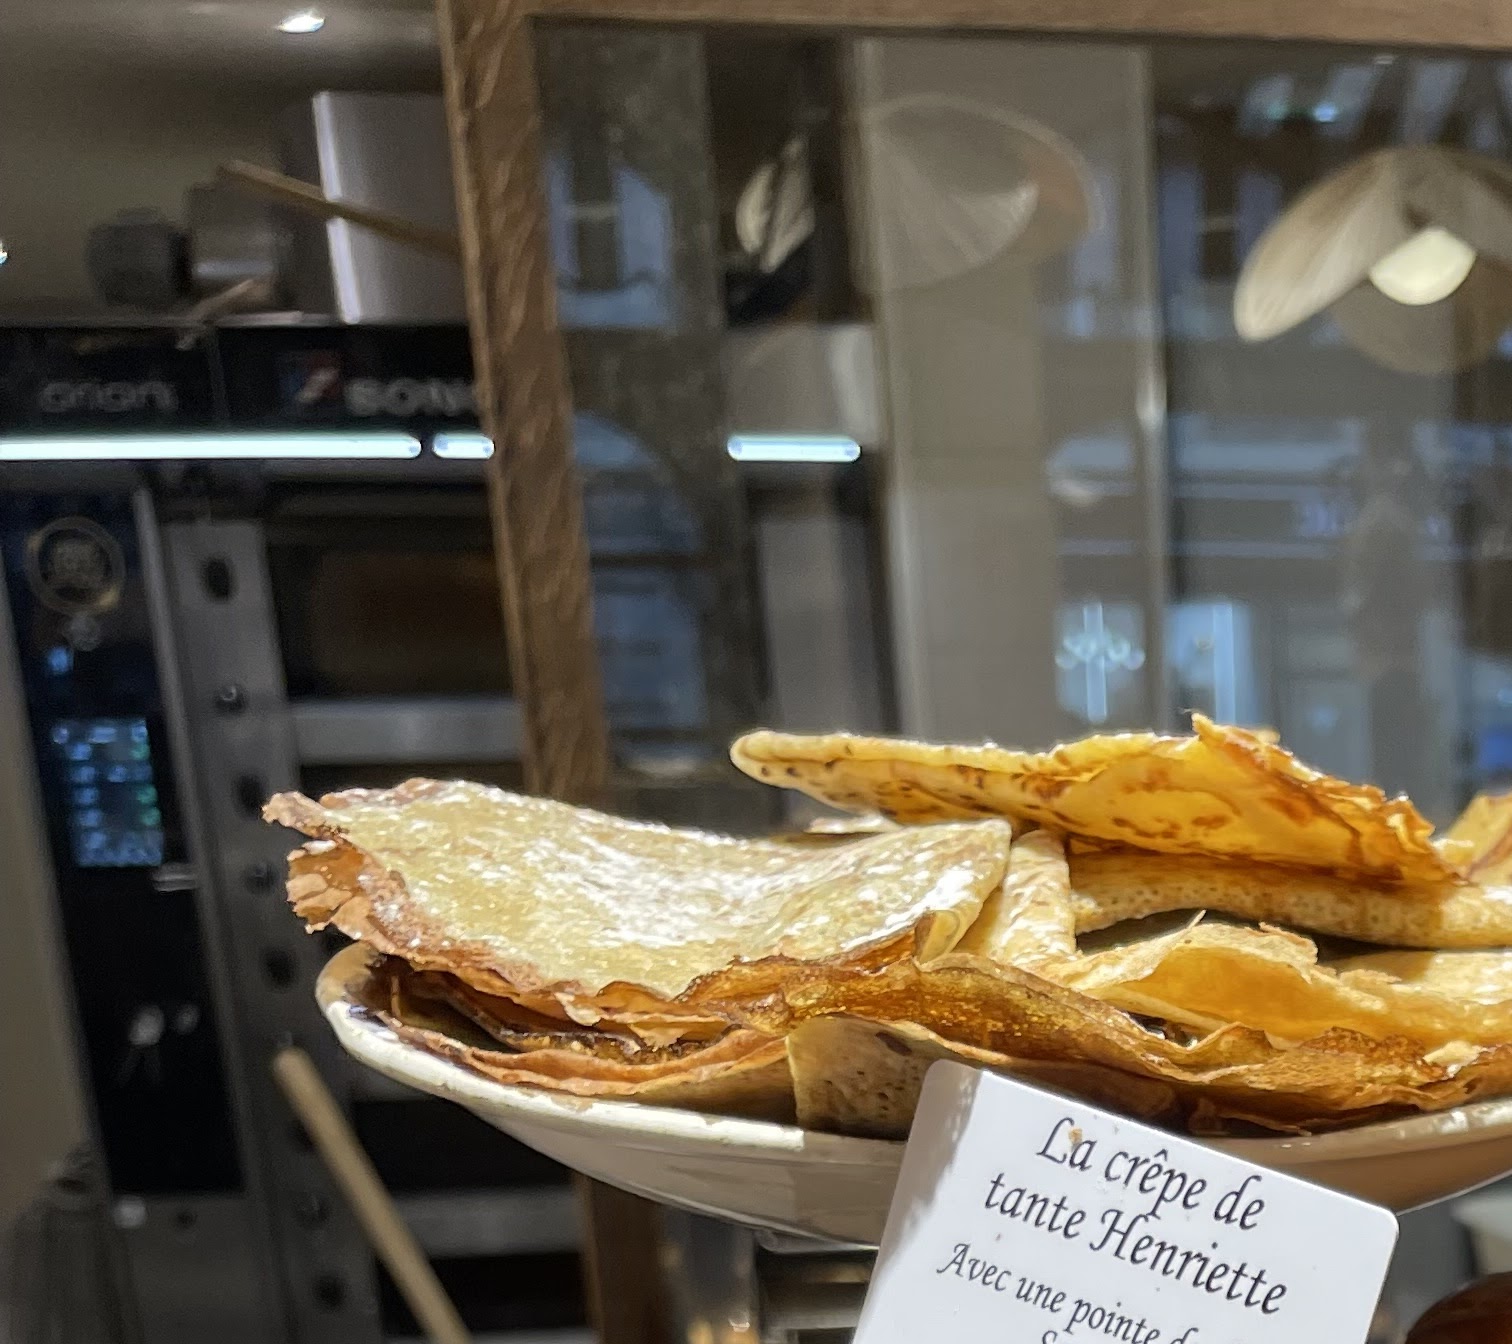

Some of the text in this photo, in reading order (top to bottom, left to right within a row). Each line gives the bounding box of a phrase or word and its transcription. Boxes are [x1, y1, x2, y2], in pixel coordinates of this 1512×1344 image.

[1035, 1115, 1266, 1231] La crêpe de
[935, 1242, 1012, 1293] Avec
[1015, 1277, 1067, 1314] une
[984, 1172, 1288, 1316] tante Henriette
